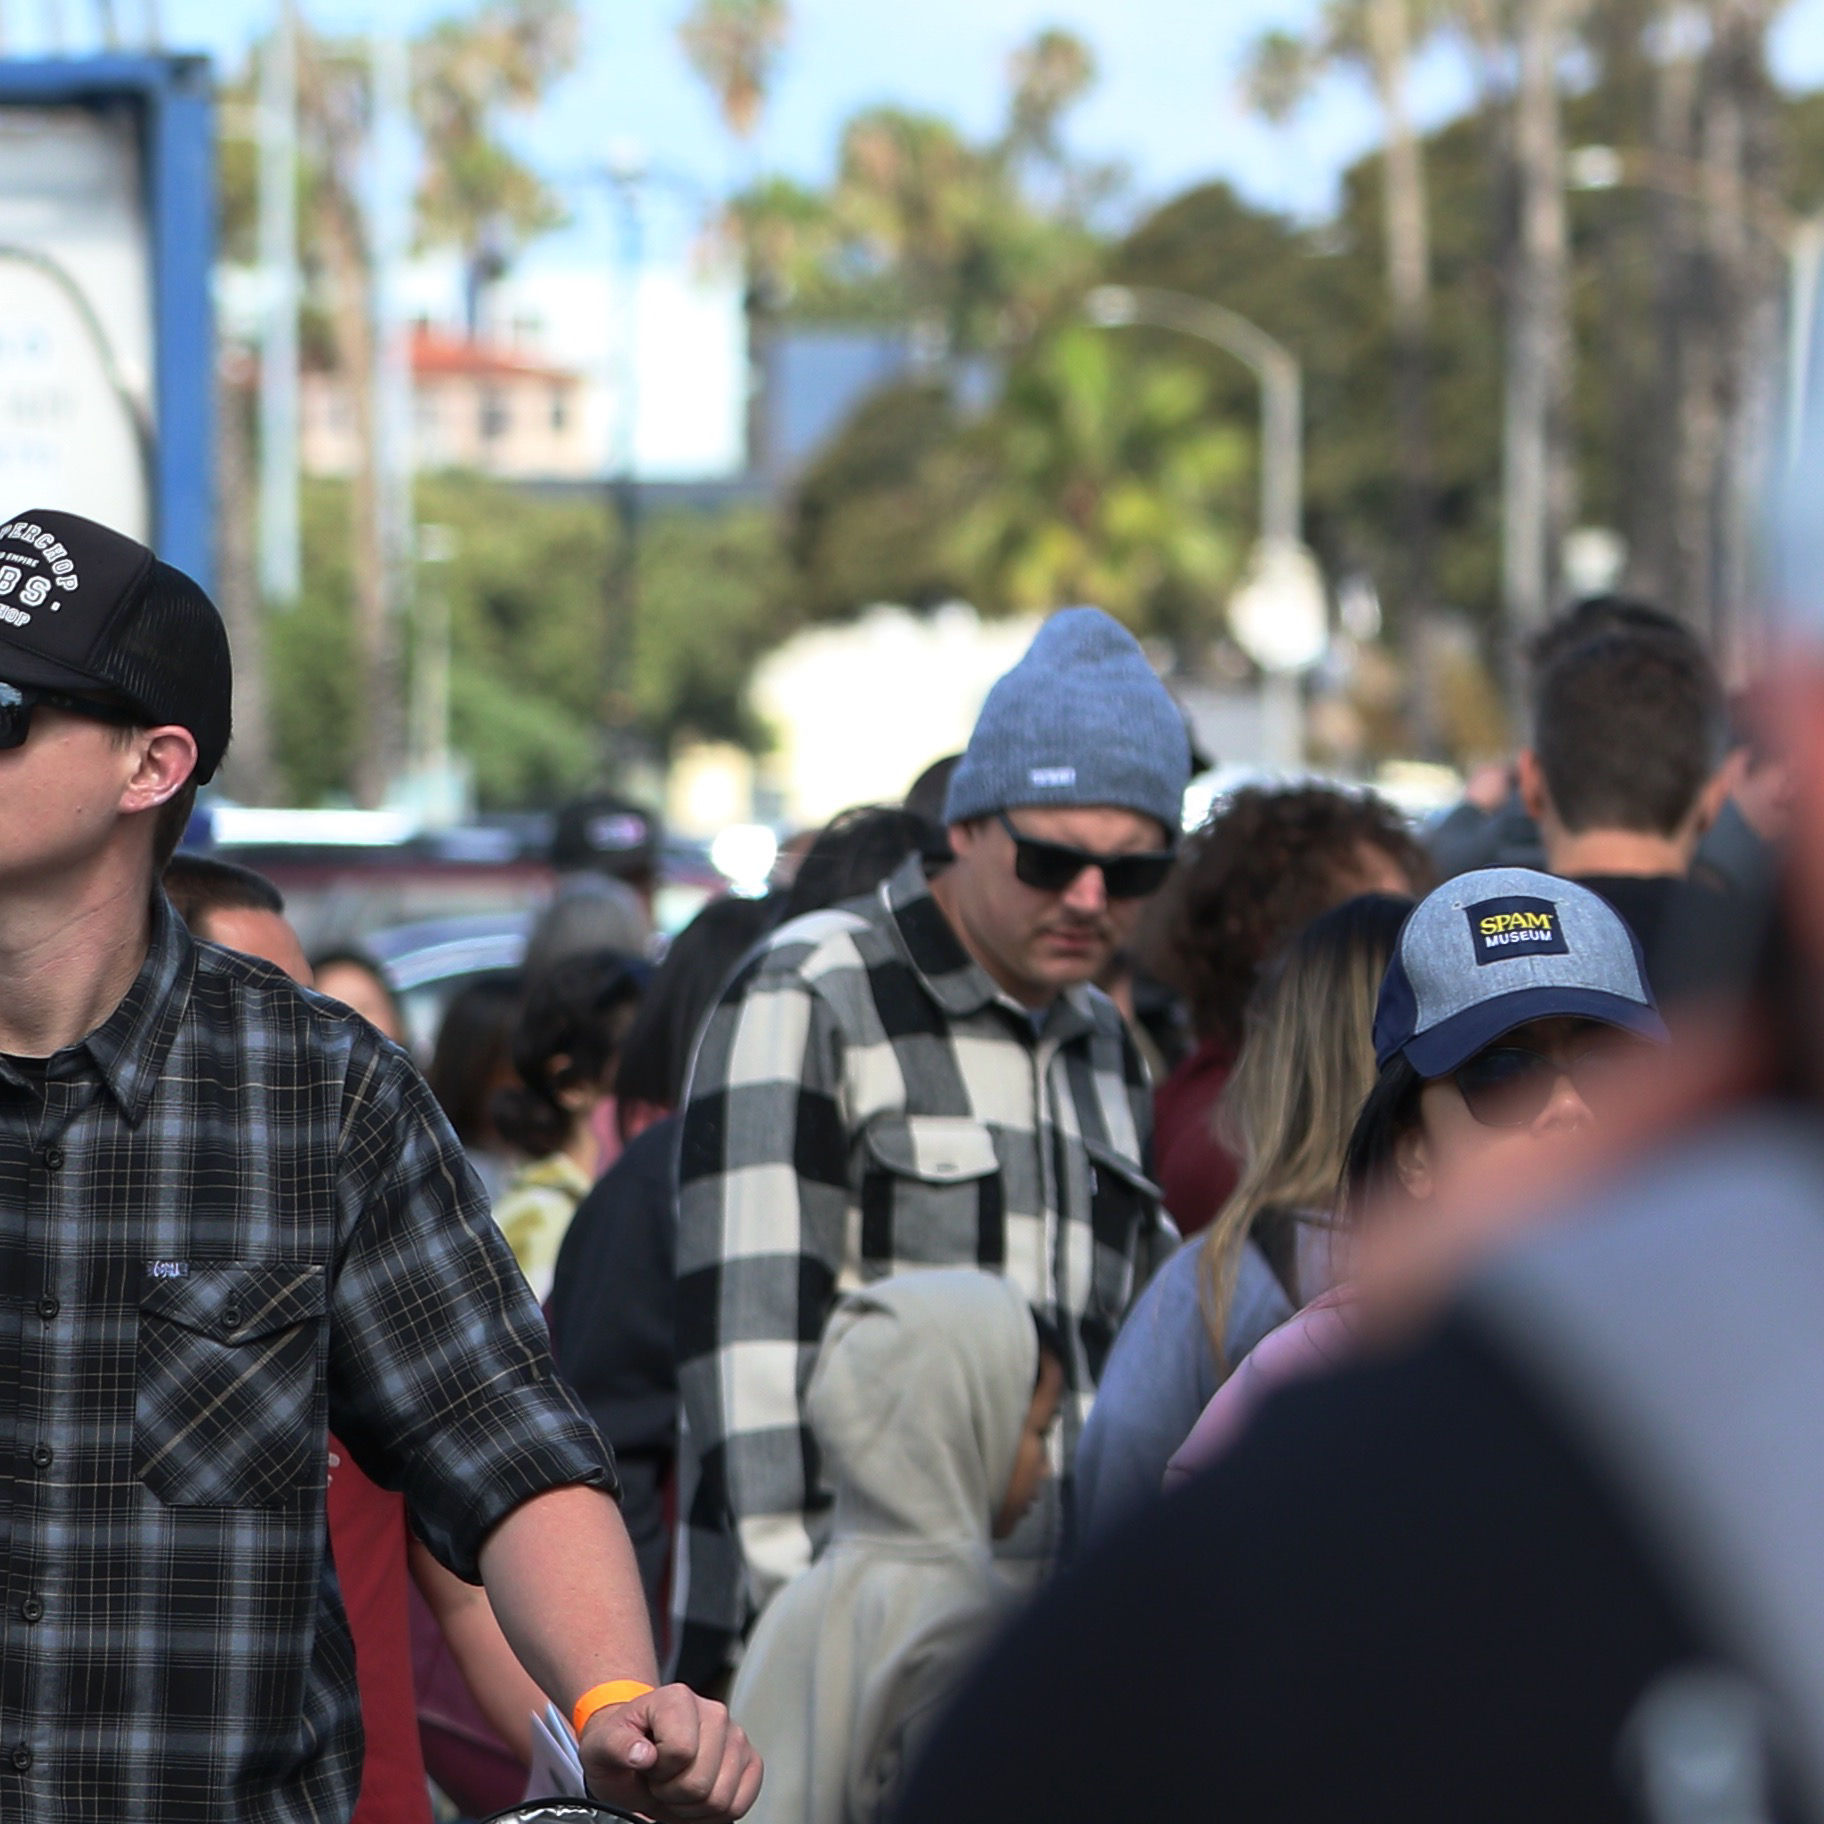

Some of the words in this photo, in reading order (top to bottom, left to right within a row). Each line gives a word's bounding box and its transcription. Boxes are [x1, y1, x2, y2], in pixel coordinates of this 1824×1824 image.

[5, 552, 40, 568] EMPIRE
[1480, 912, 1552, 935] SPAM
[1485, 930, 1552, 948] MUSEUM
